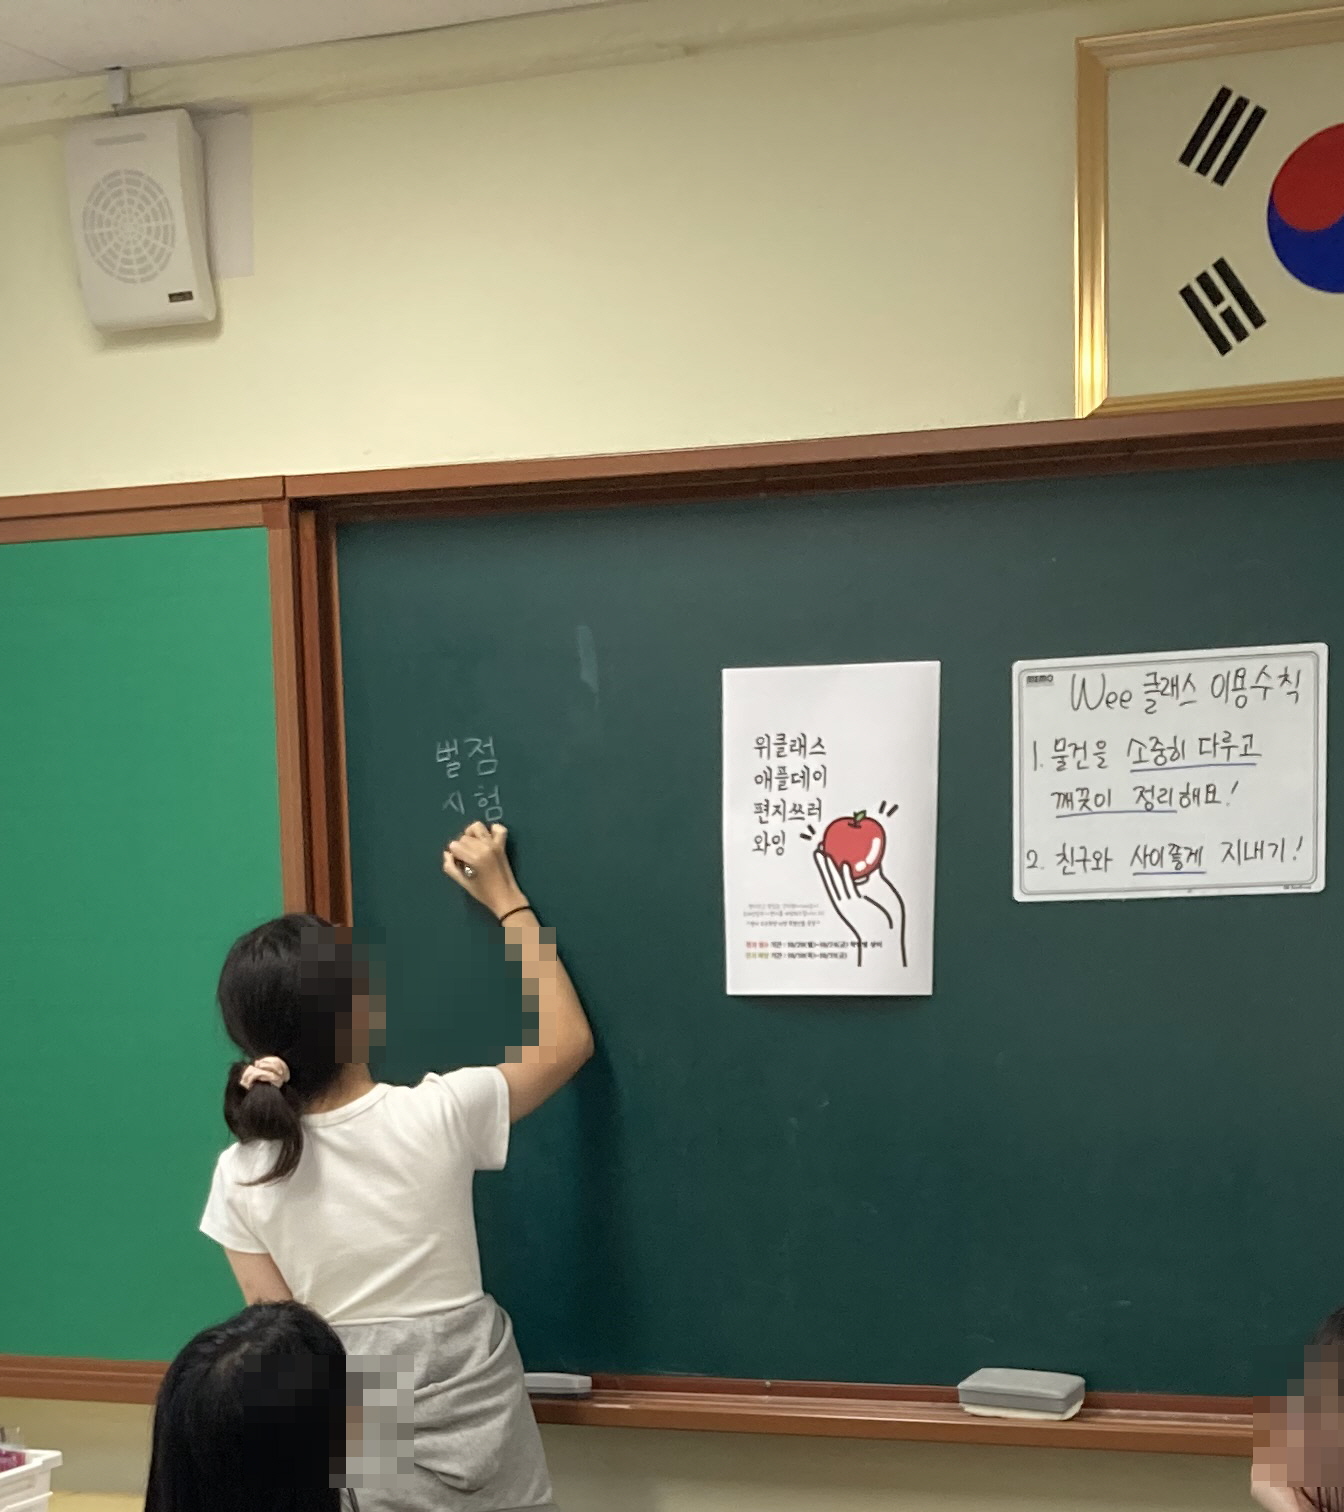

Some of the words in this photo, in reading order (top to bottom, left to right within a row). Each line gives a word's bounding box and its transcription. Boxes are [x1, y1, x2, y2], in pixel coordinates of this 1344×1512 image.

[1070, 673, 1133, 712] Wee
[1142, 670, 1198, 714] 클래스
[1210, 664, 1302, 709] 이용수칙
[436, 736, 498, 778] 벌점
[754, 732, 827, 760] 위클래스
[1033, 740, 1044, 771] 1.
[1051, 738, 1108, 772] 물건을
[1126, 735, 1186, 767] 소중히
[1198, 730, 1262, 763] 다루고
[754, 764, 827, 792] 애플데이
[442, 784, 503, 821] 시험
[753, 797, 822, 824] 편지쓰러
[752, 829, 786, 856] 와잉
[1026, 850, 1045, 871] 2.
[1055, 842, 1113, 875] 친구와
[1220, 835, 1303, 866] 지내기!
